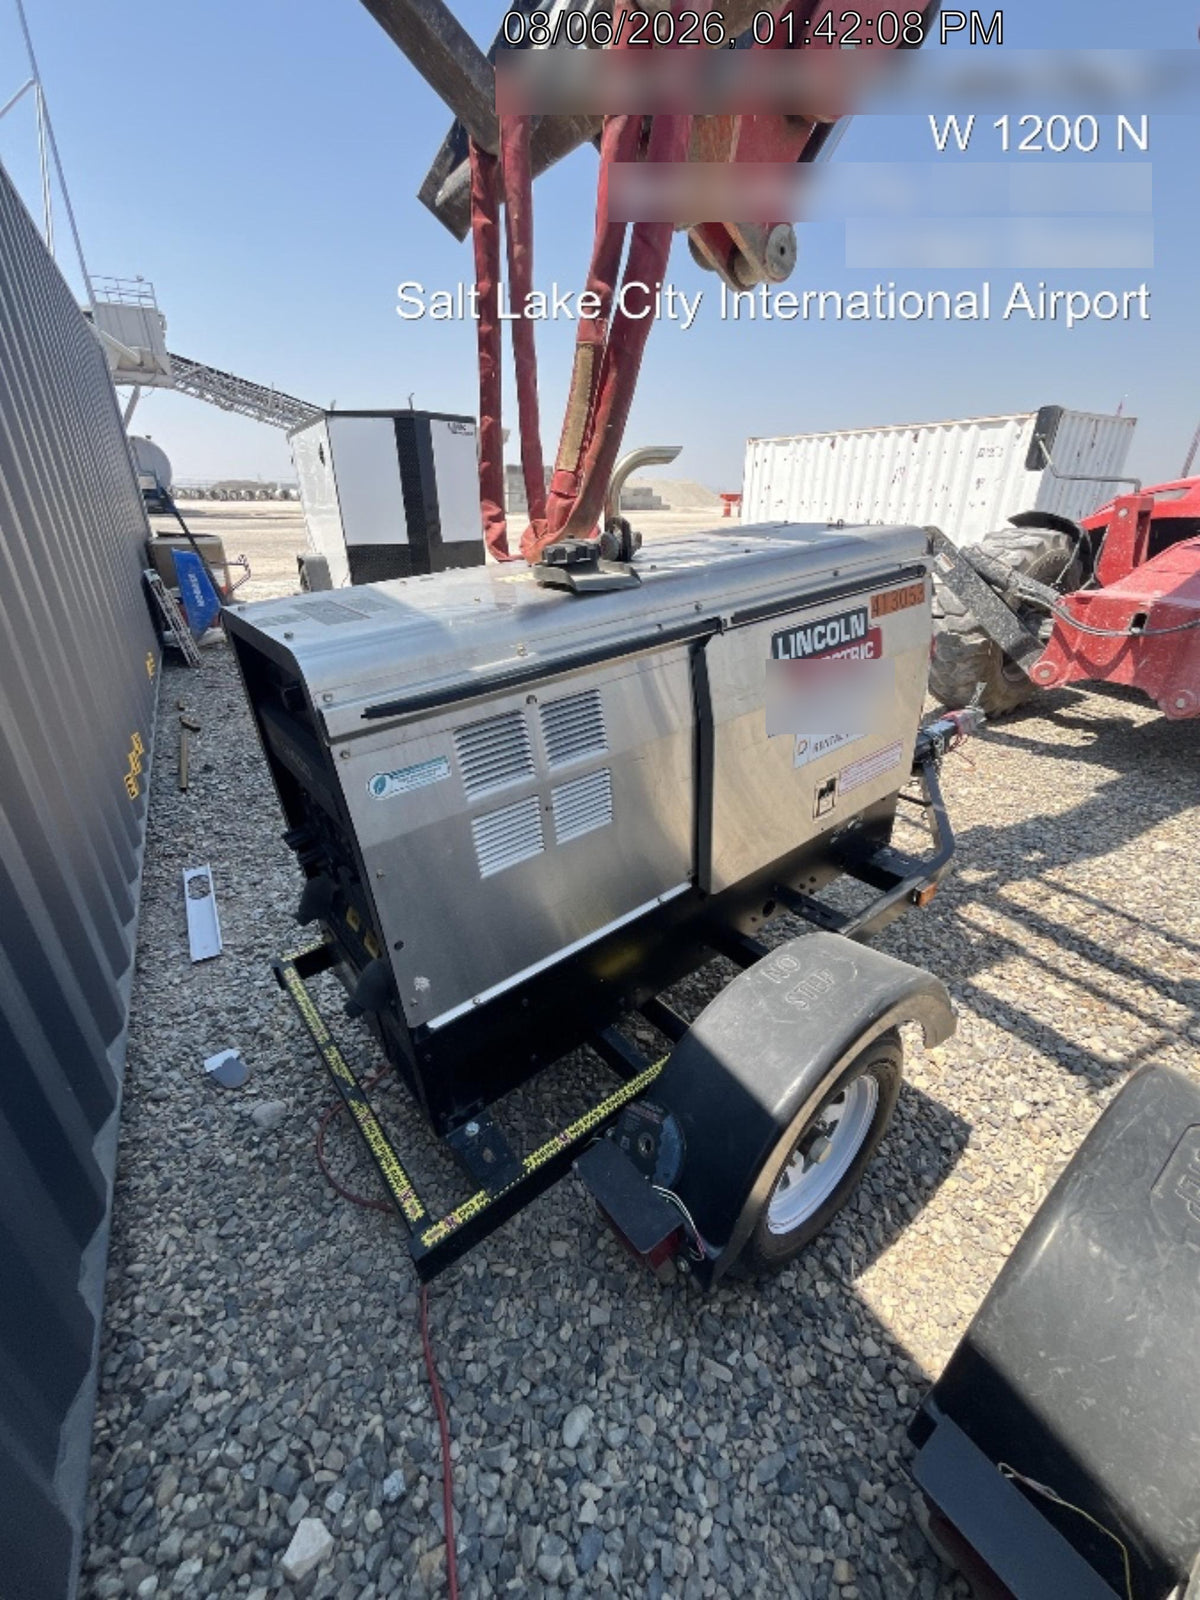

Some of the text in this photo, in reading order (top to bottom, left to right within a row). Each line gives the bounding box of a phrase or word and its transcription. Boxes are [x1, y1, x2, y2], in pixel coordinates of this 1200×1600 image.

[777, 613, 865, 659] LINCOLN
[760, 954, 800, 984] NO
[785, 968, 835, 1010] STEP
